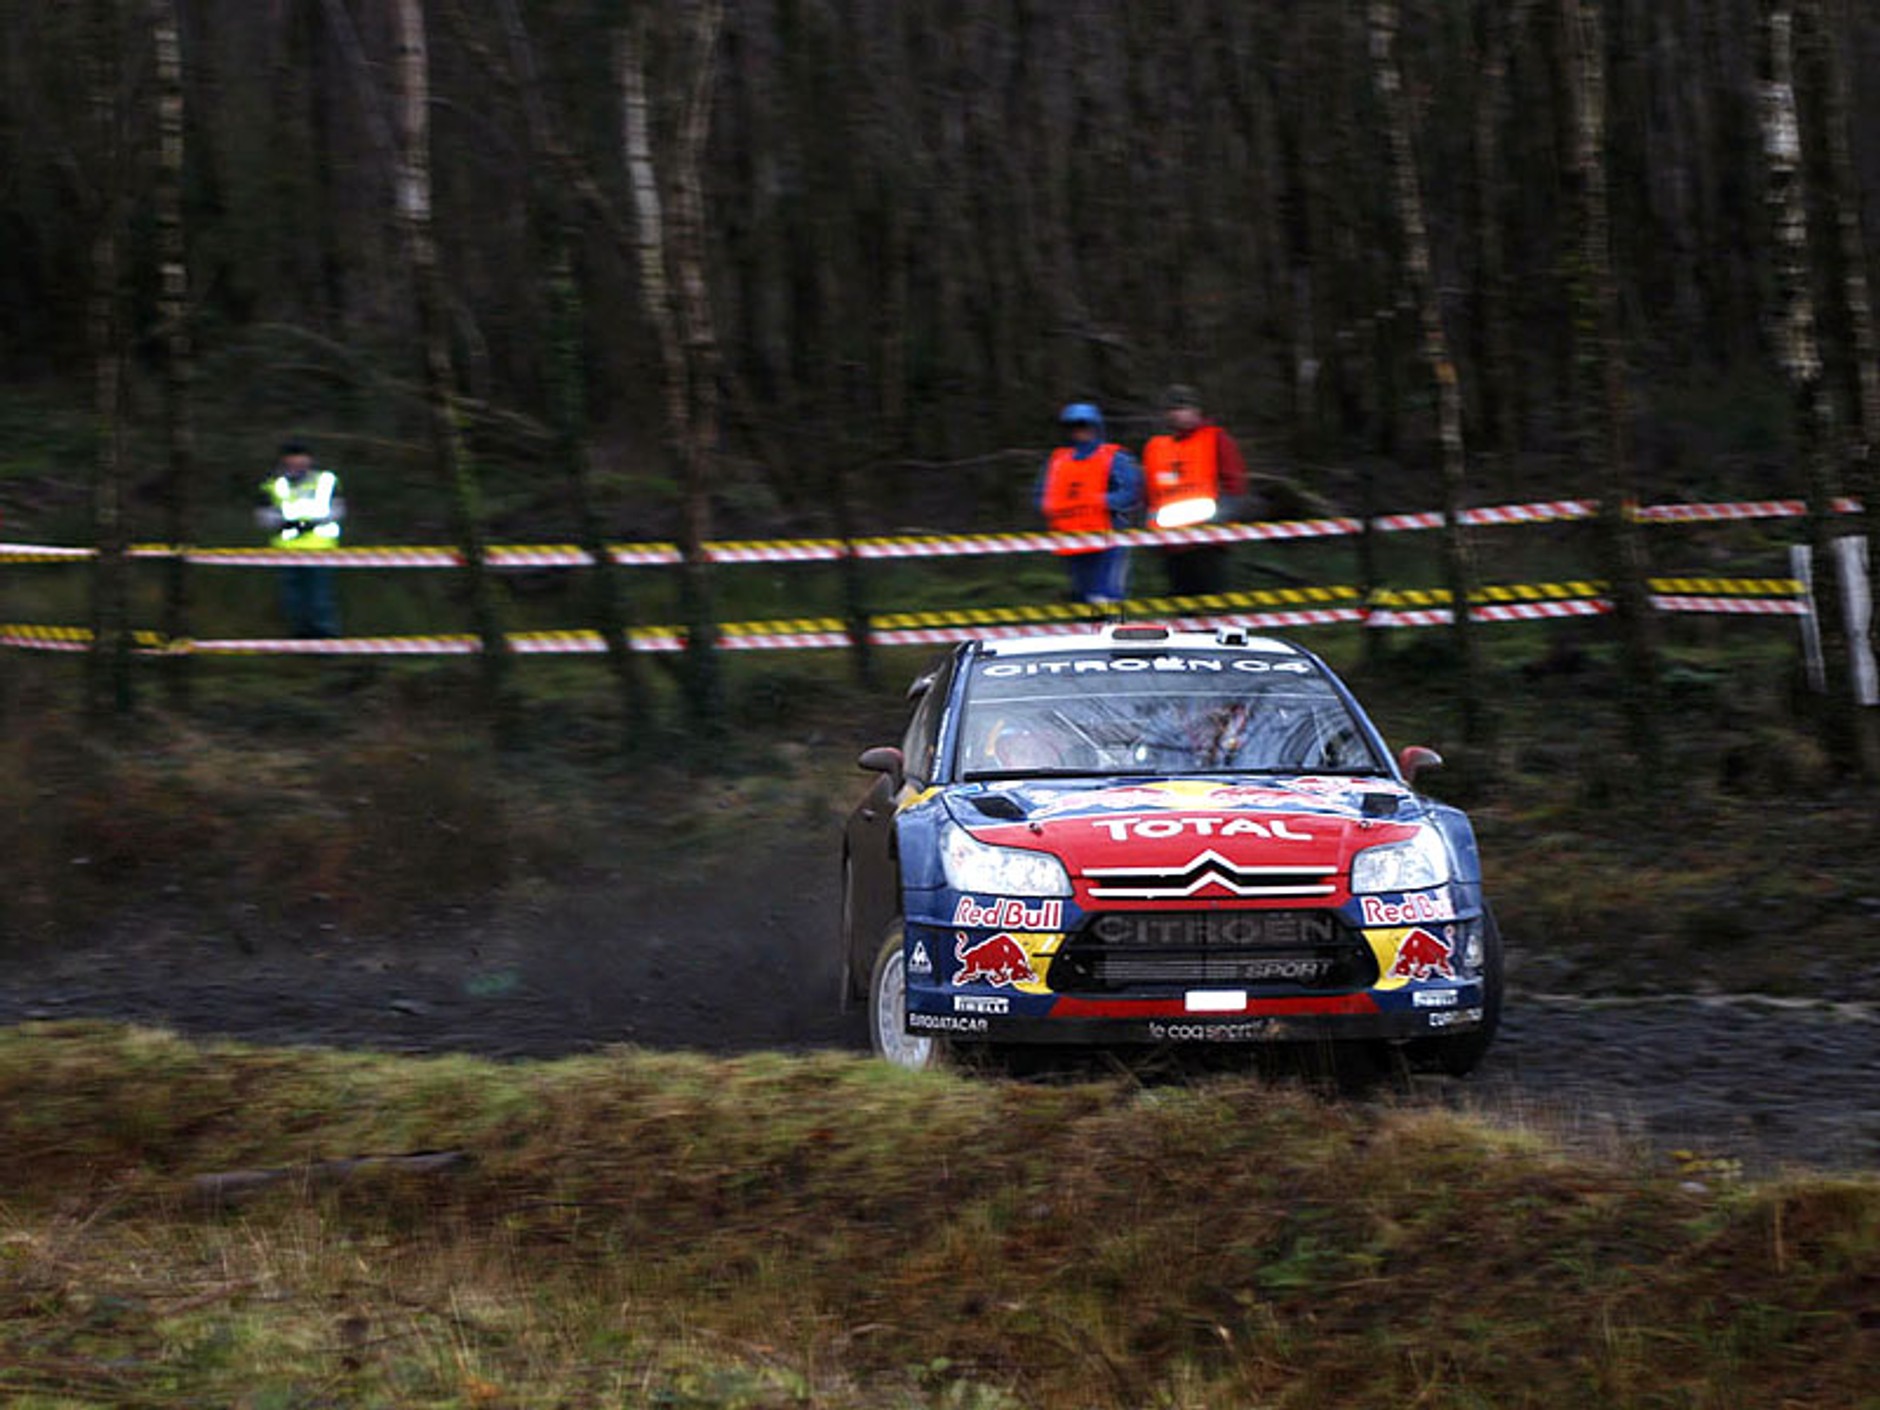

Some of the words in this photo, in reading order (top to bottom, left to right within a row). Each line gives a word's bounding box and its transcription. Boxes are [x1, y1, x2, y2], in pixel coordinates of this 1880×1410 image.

[983, 656, 1222, 676] CITROËN
[1232, 659, 1312, 674] C4
[1093, 817, 1312, 840] TOTAL
[954, 898, 1003, 927] Red
[1004, 901, 1061, 928] Bull
[1364, 894, 1417, 923] Red
[1095, 912, 1333, 942] CITROËN
